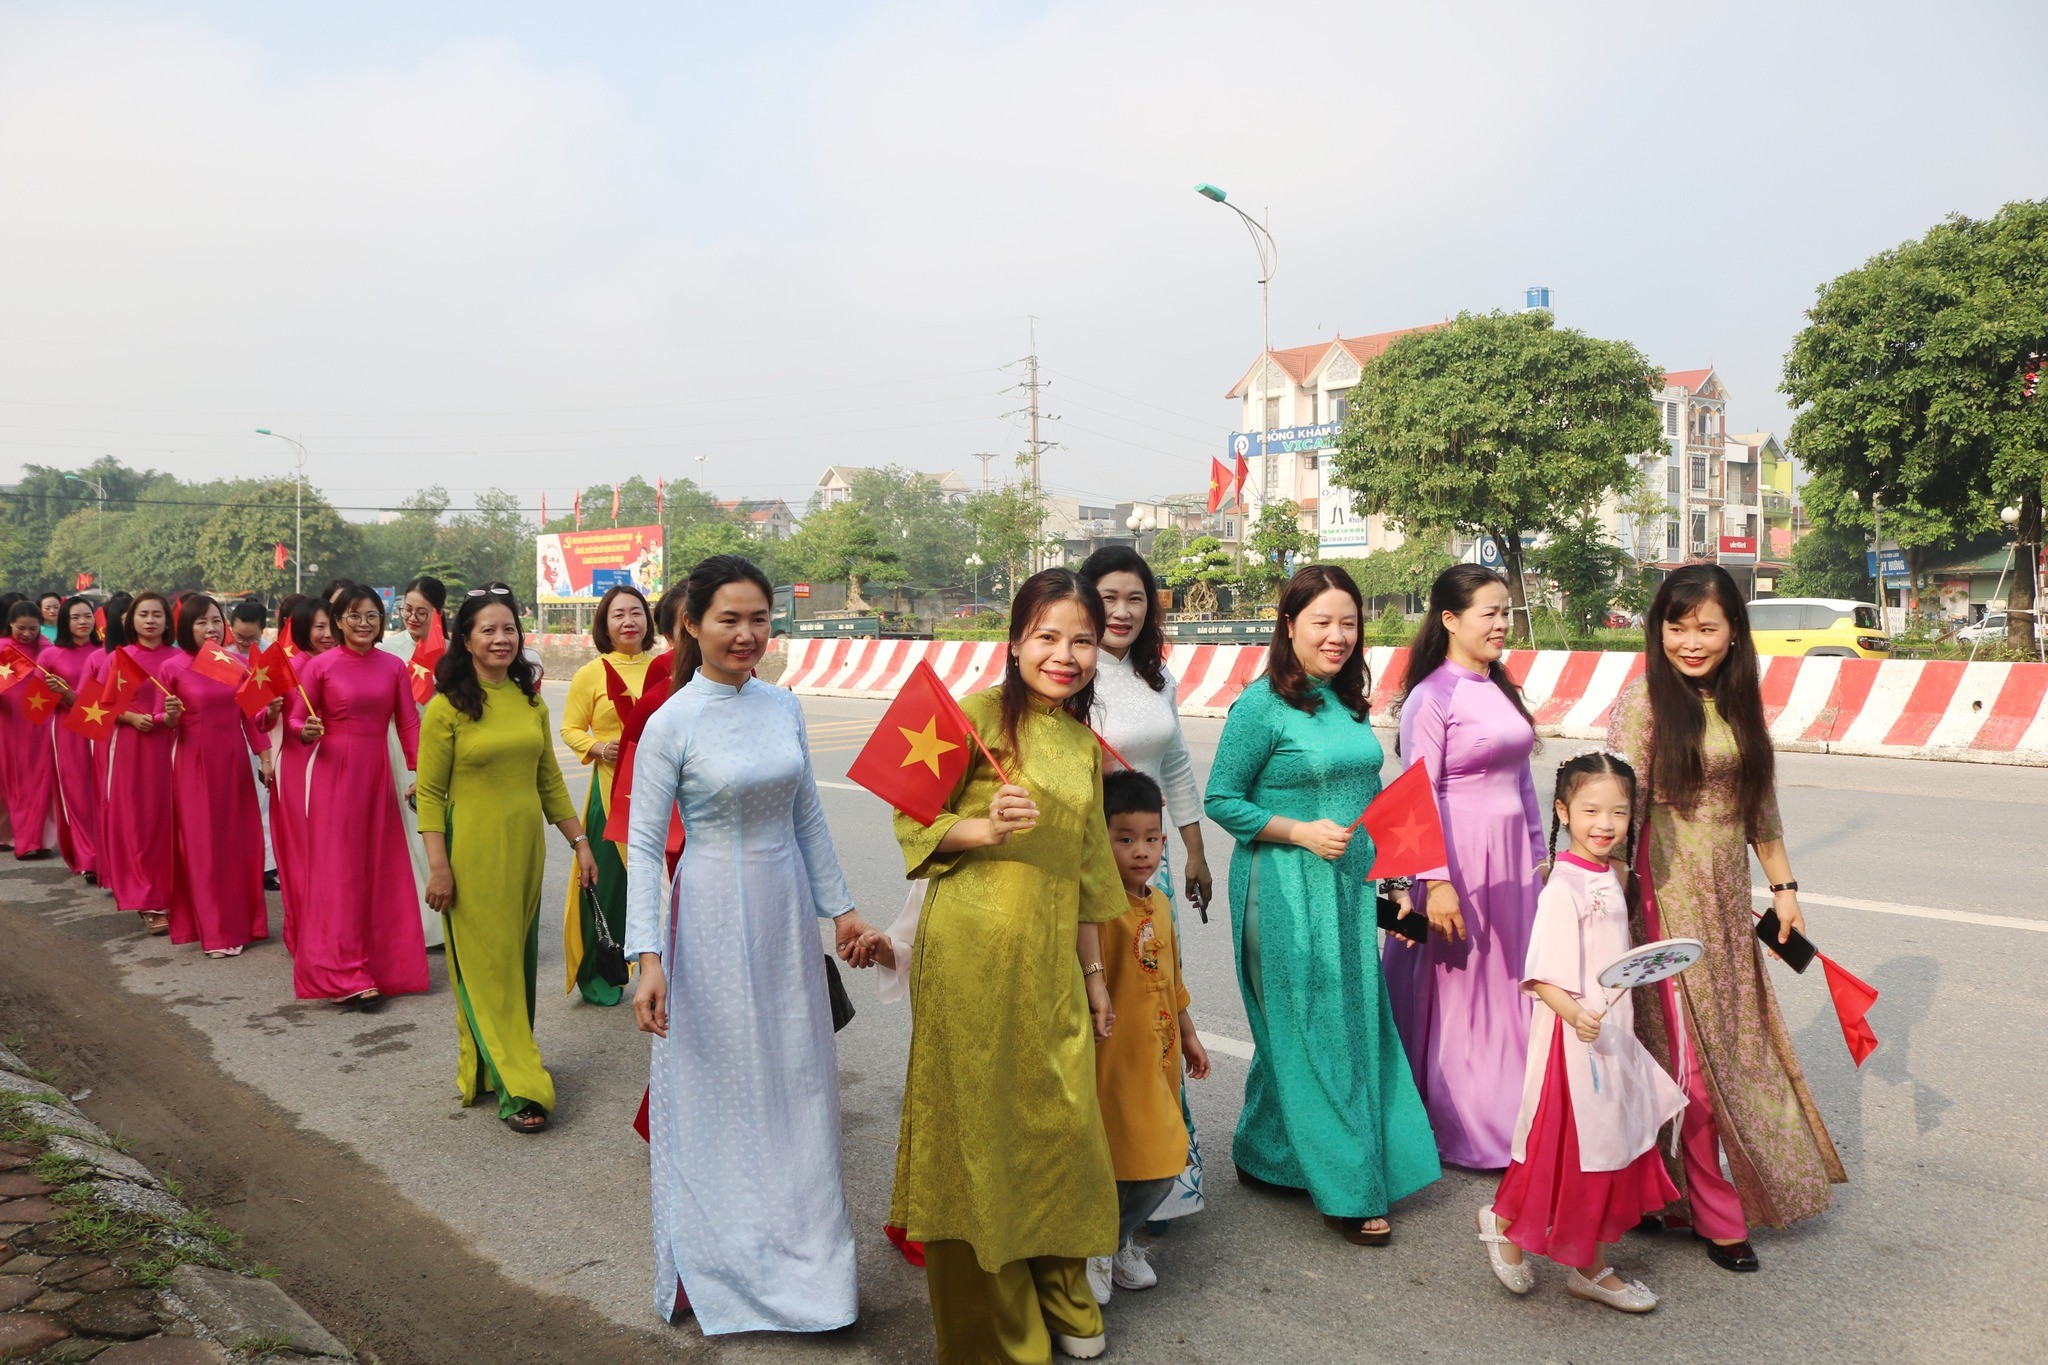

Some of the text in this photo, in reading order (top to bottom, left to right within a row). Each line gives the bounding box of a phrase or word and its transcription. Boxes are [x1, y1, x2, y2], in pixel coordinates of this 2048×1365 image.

[1256, 430, 1294, 443] PHÒNG
[1298, 425, 1331, 438] KHÁM
[1197, 626, 1208, 634] BÁN
[1218, 625, 1232, 633] CẢNH
